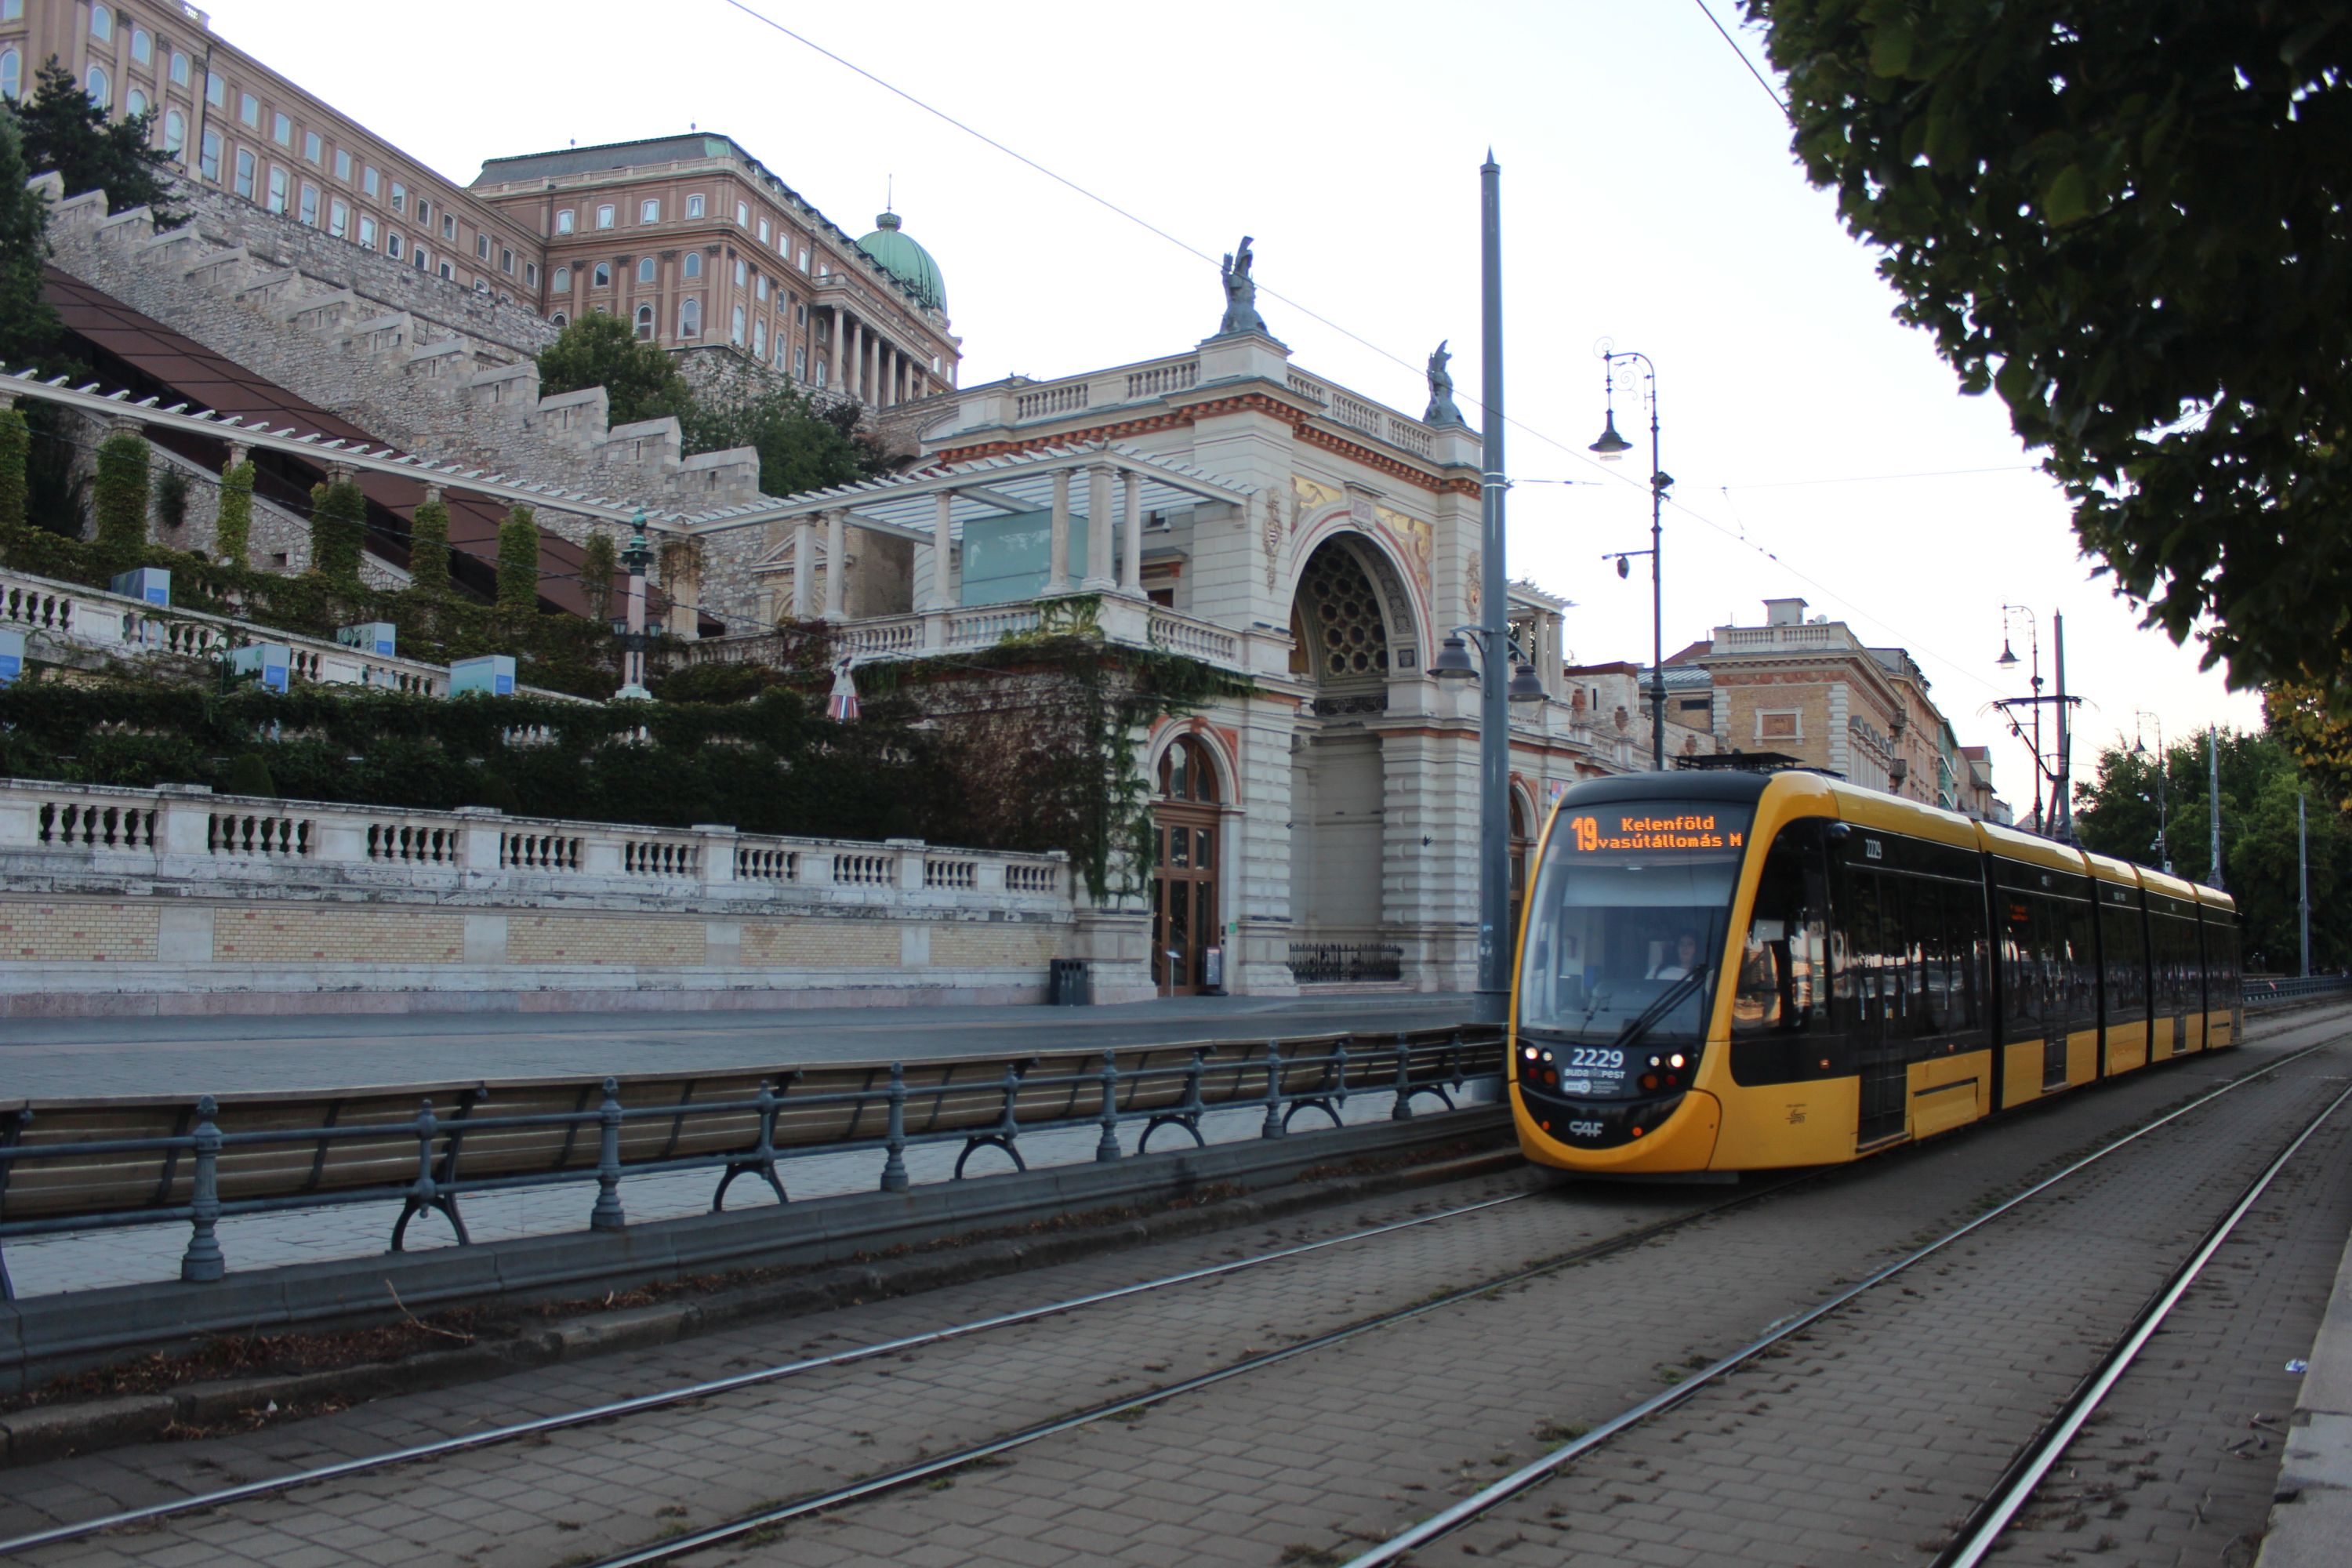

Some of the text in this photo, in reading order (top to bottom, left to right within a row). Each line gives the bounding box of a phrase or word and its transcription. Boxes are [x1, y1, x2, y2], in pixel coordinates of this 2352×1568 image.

[1622, 816, 1715, 831] Kelenföld
[1571, 816, 1598, 851] 19
[1598, 833, 1742, 849] vasútállomás M
[1865, 838, 1882, 859] 2229
[1571, 1048, 1624, 1069] 2229
[1569, 1121, 1603, 1137] CAF
